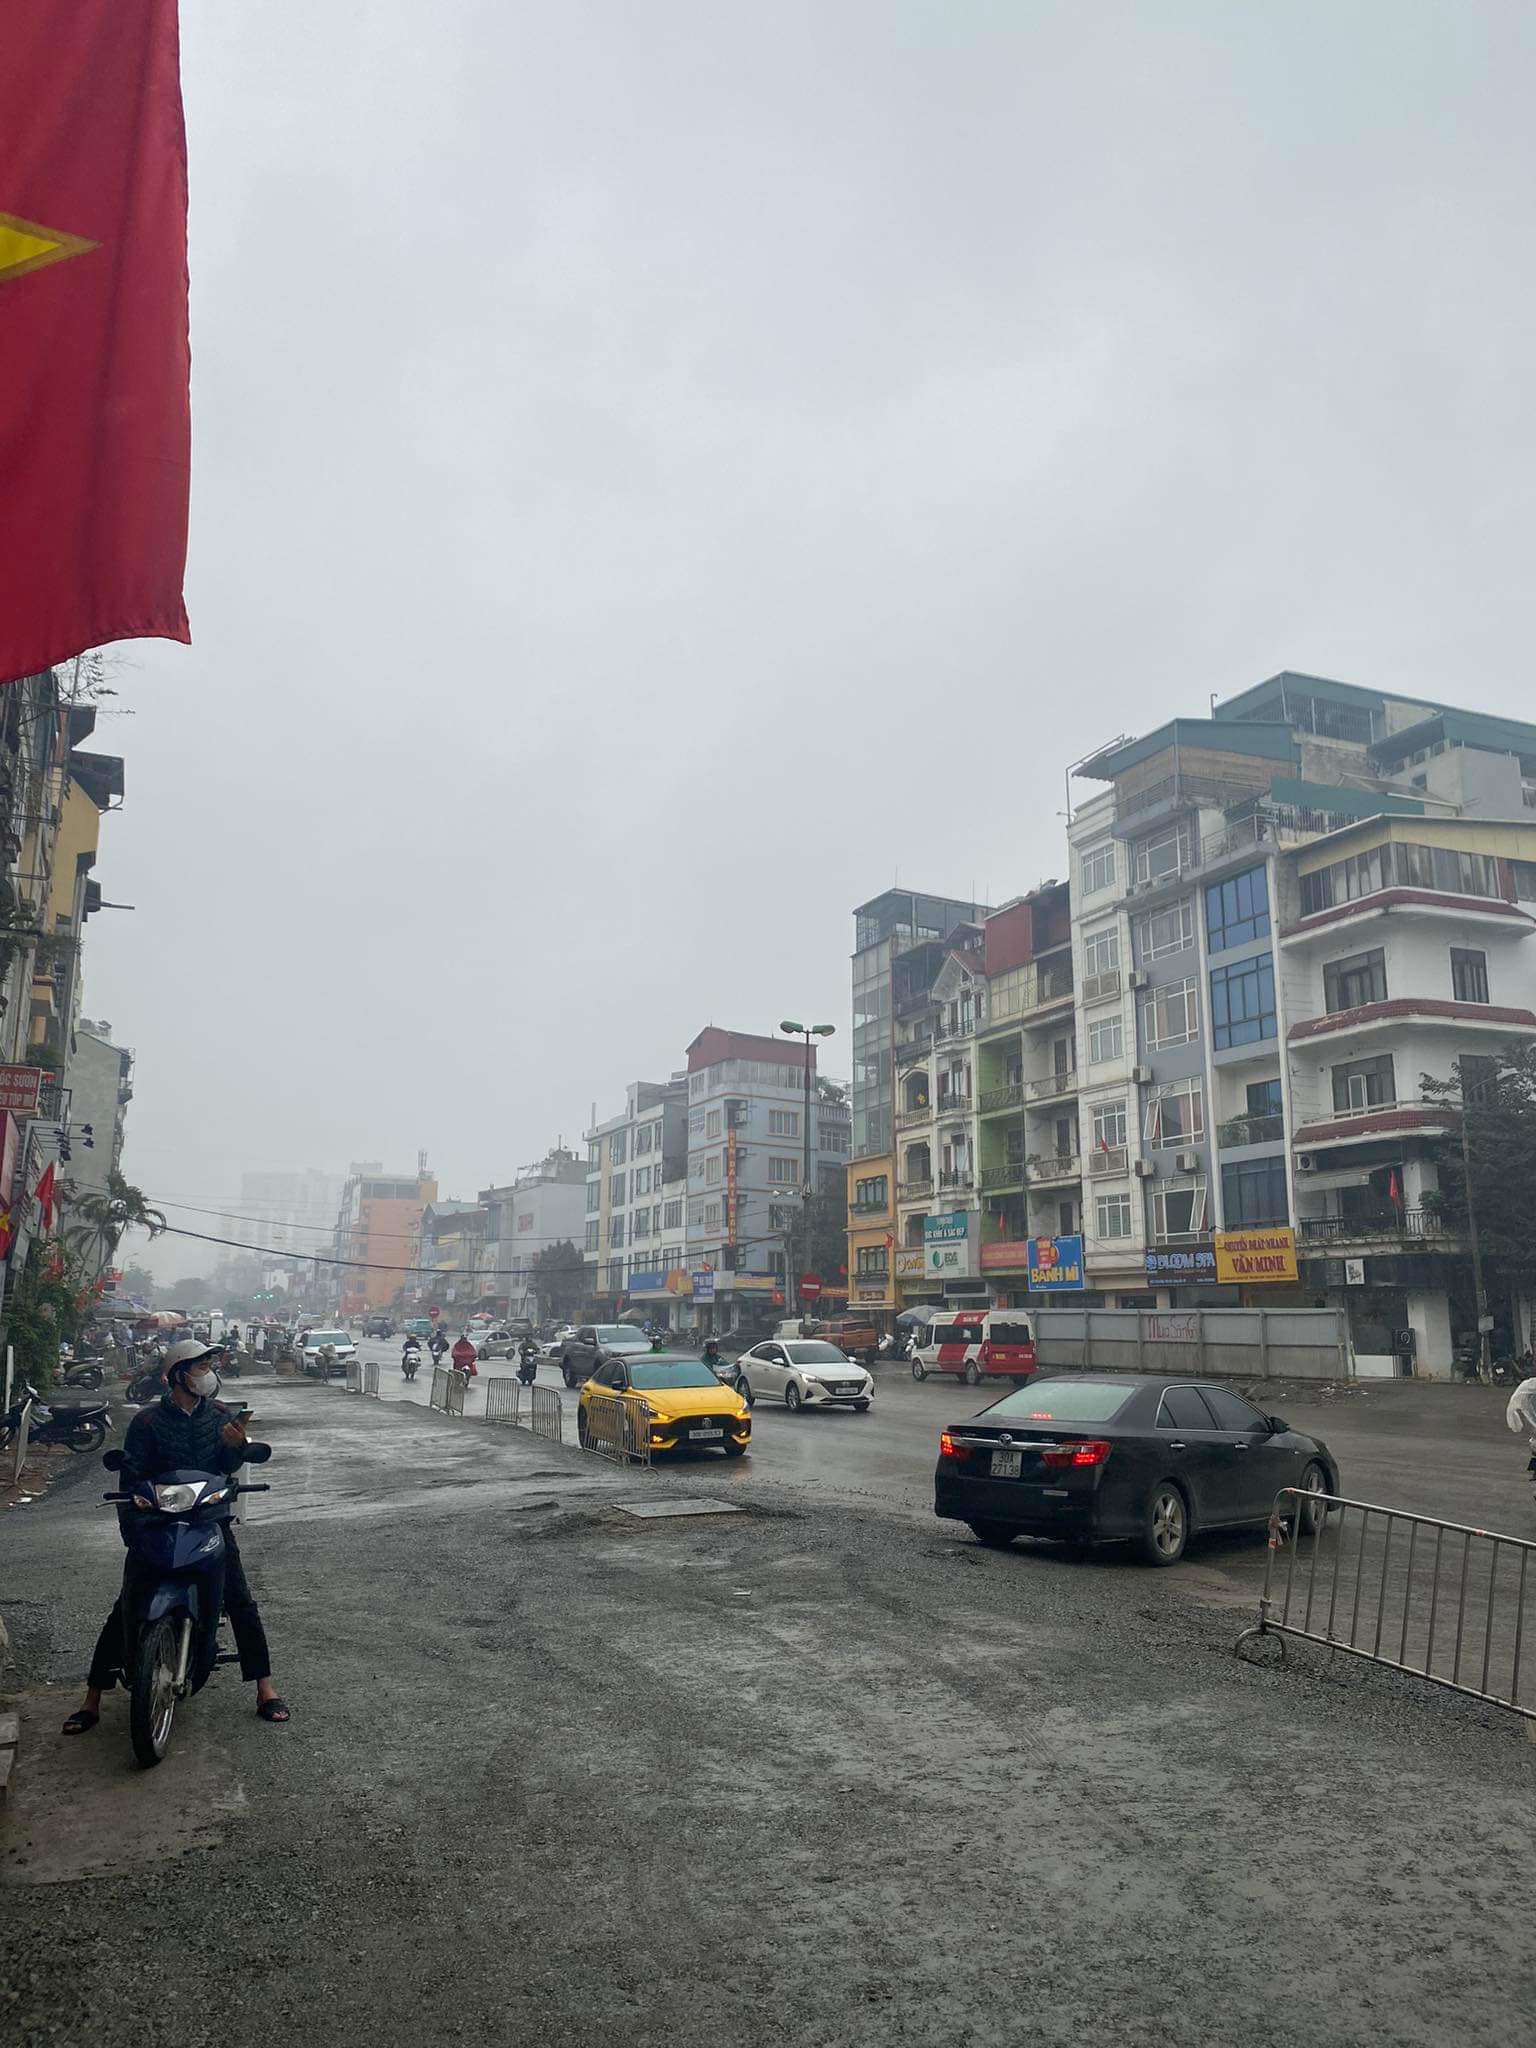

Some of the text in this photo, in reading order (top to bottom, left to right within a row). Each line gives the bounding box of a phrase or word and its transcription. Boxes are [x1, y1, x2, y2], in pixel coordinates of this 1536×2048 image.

[1157, 1252, 1216, 1269] BLOOM SPA
[1254, 1254, 1287, 1272] MINH
